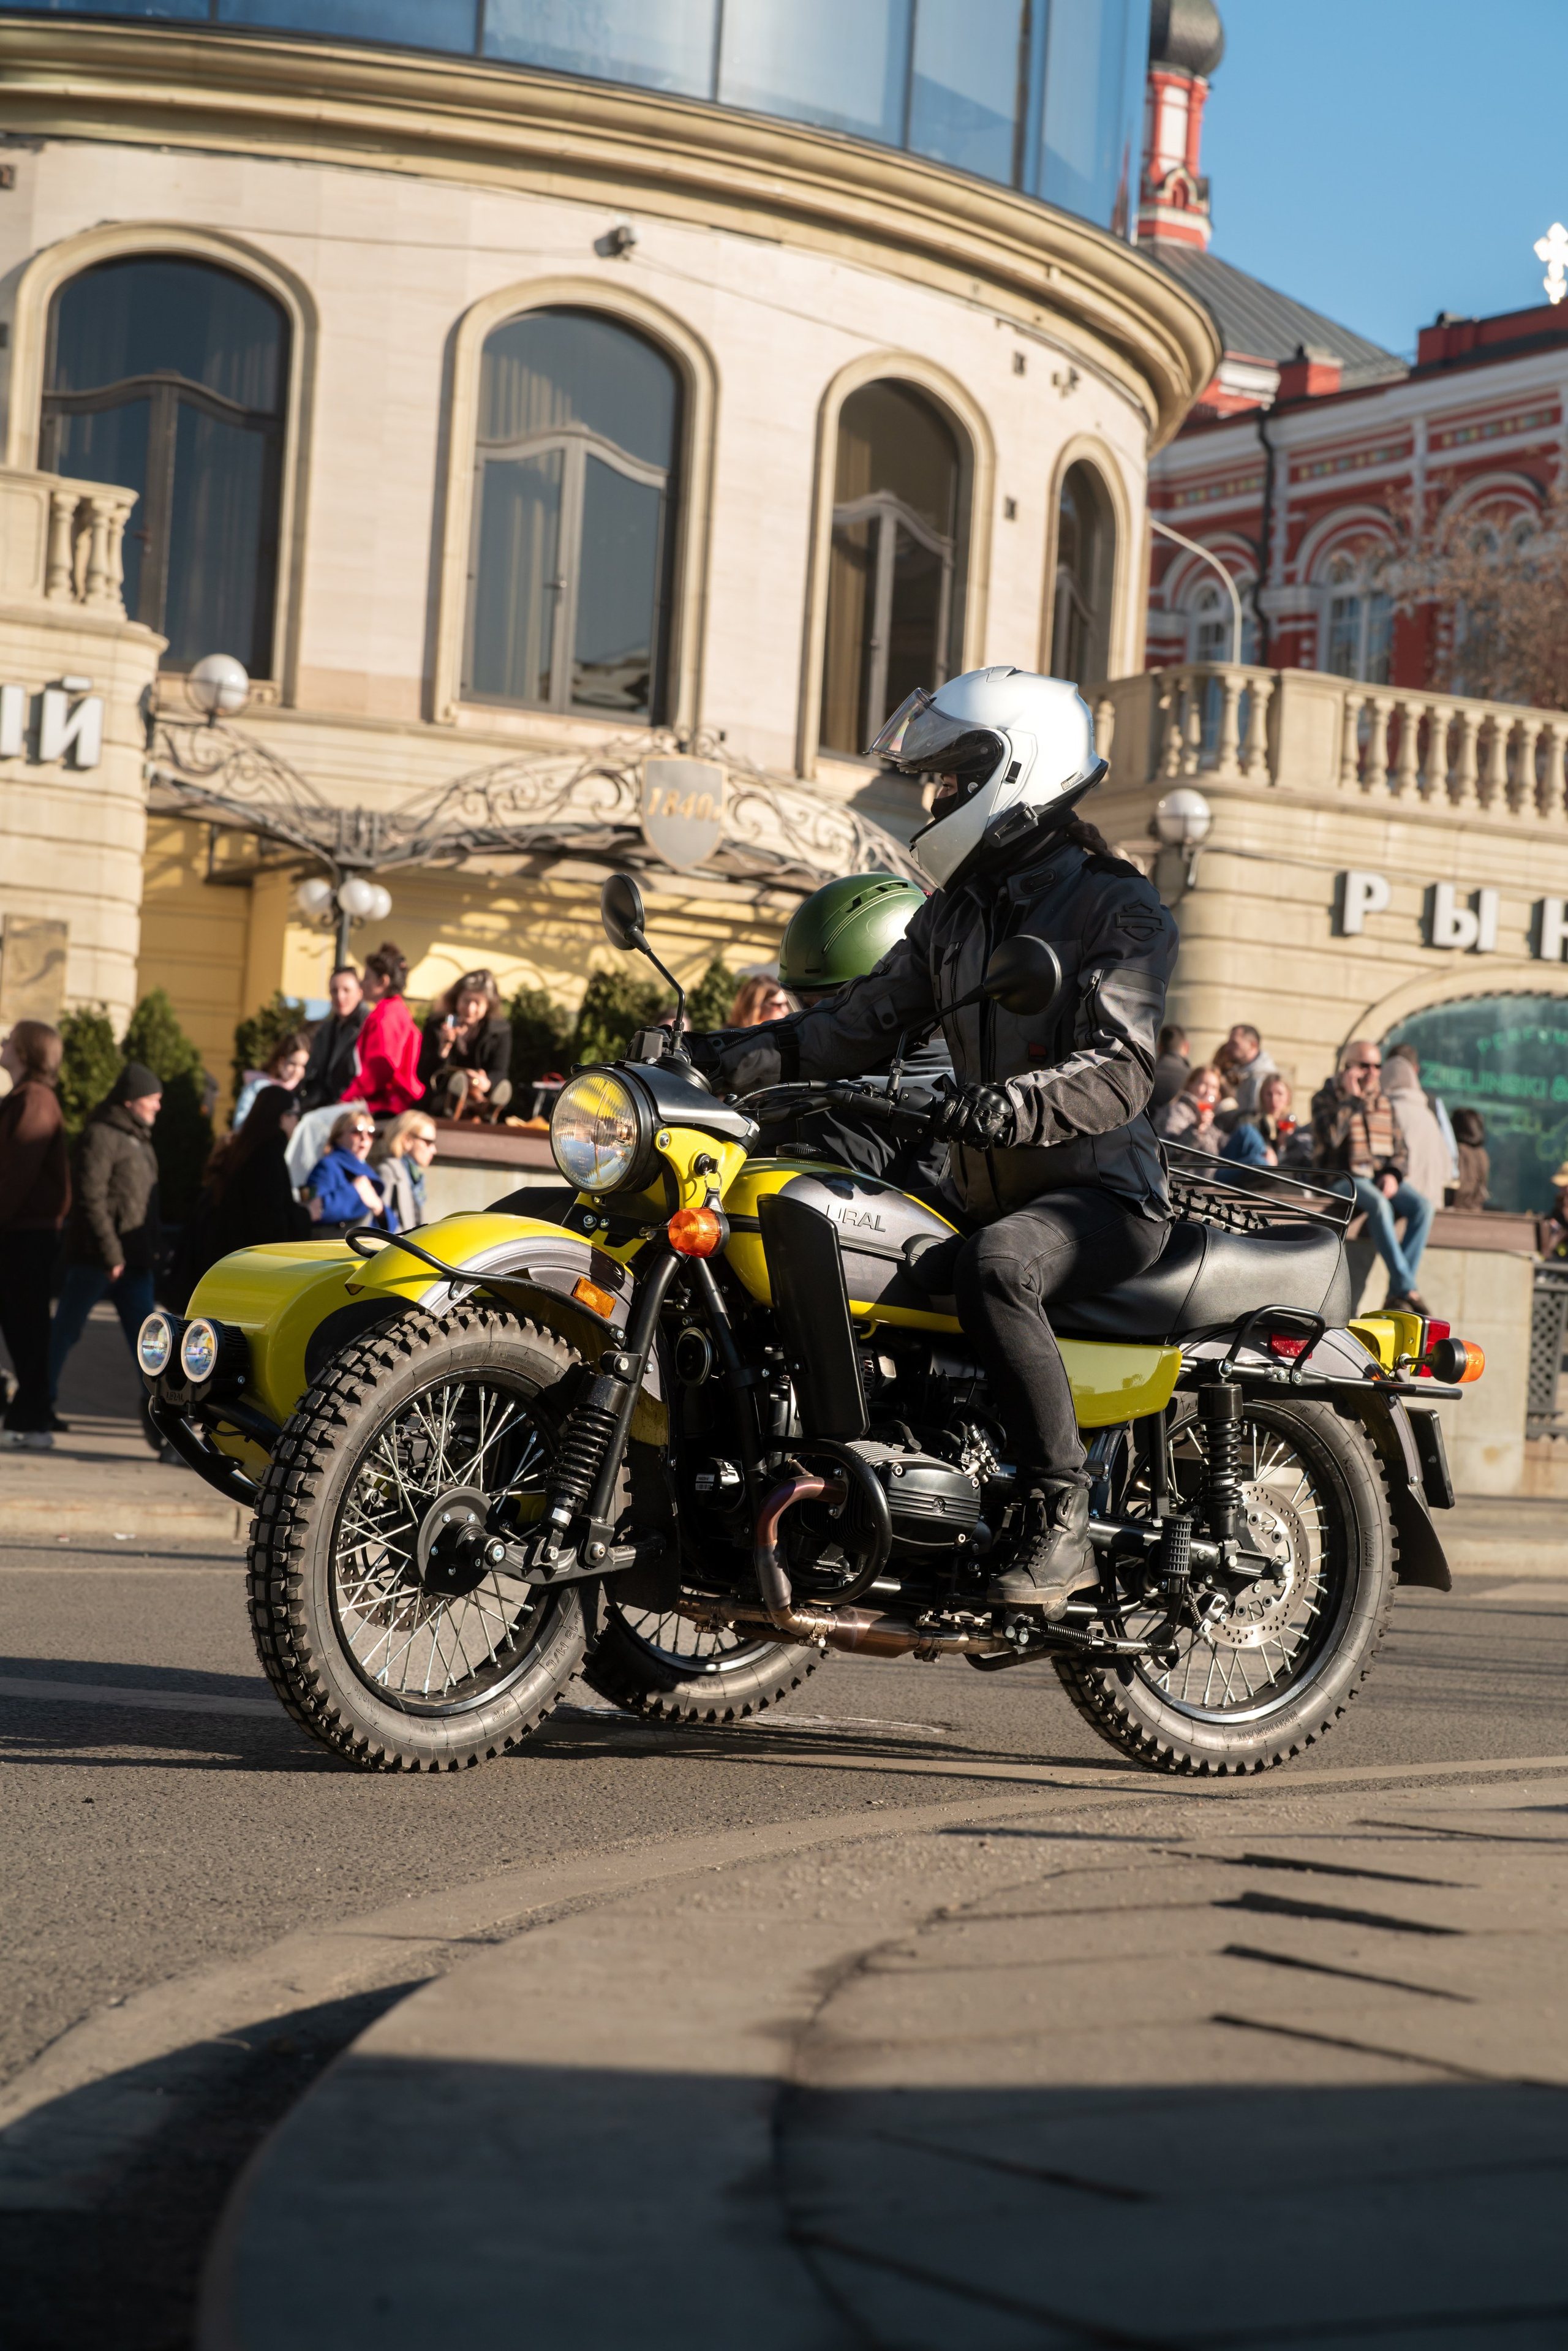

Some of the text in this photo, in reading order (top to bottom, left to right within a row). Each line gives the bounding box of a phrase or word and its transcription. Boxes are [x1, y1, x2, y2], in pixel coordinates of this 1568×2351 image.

[826, 1204, 886, 1232] URAL
[546, 1641, 569, 1670] M/C
[1237, 1710, 1300, 1742] HEIDENAU
